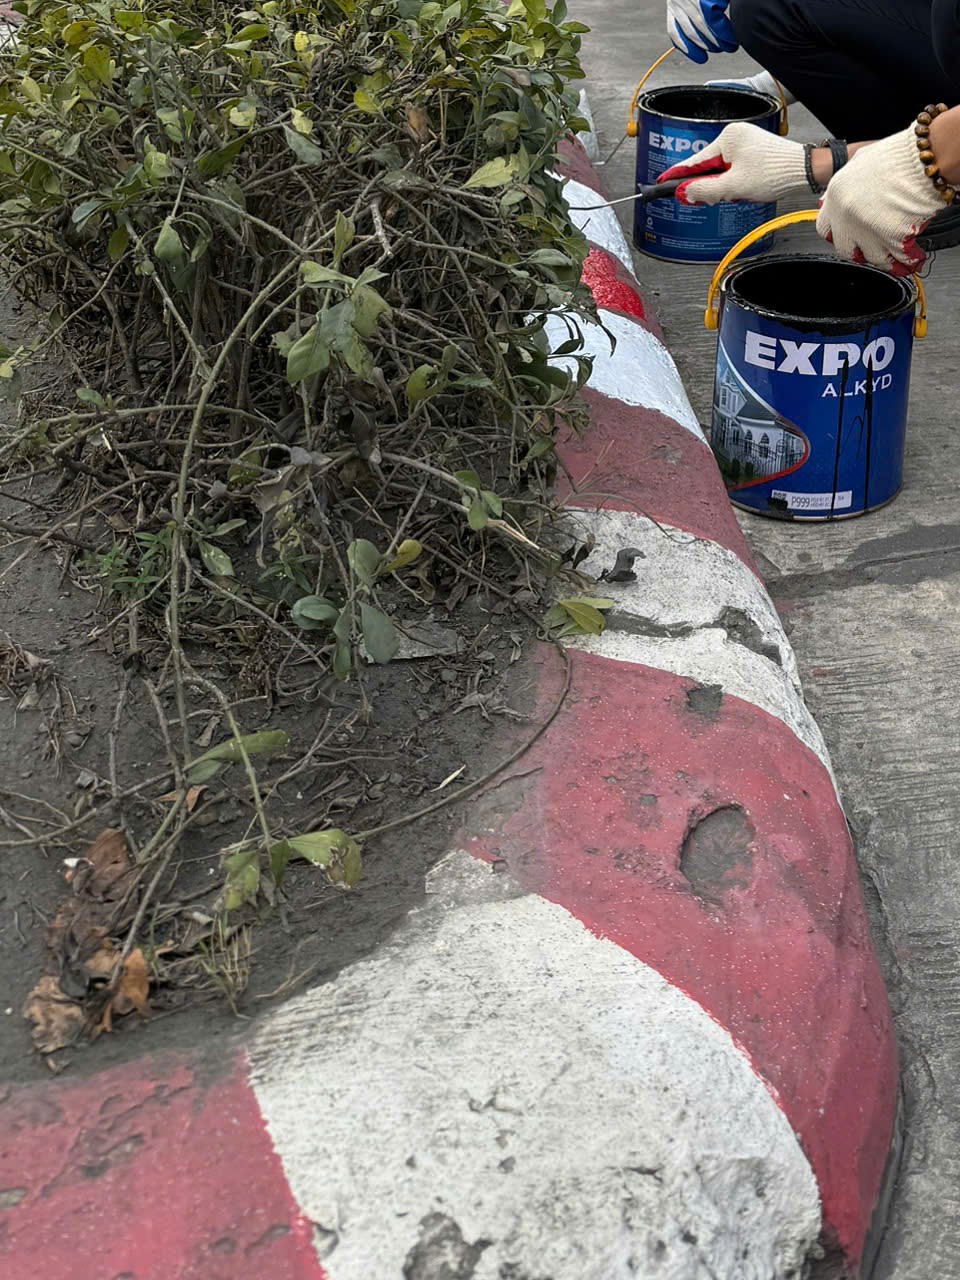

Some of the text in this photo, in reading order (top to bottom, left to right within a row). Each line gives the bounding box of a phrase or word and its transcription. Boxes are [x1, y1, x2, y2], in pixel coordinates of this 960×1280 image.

[648, 131, 709, 153] EXPO
[744, 330, 896, 376] EXPO
[791, 496, 810, 508] P999
